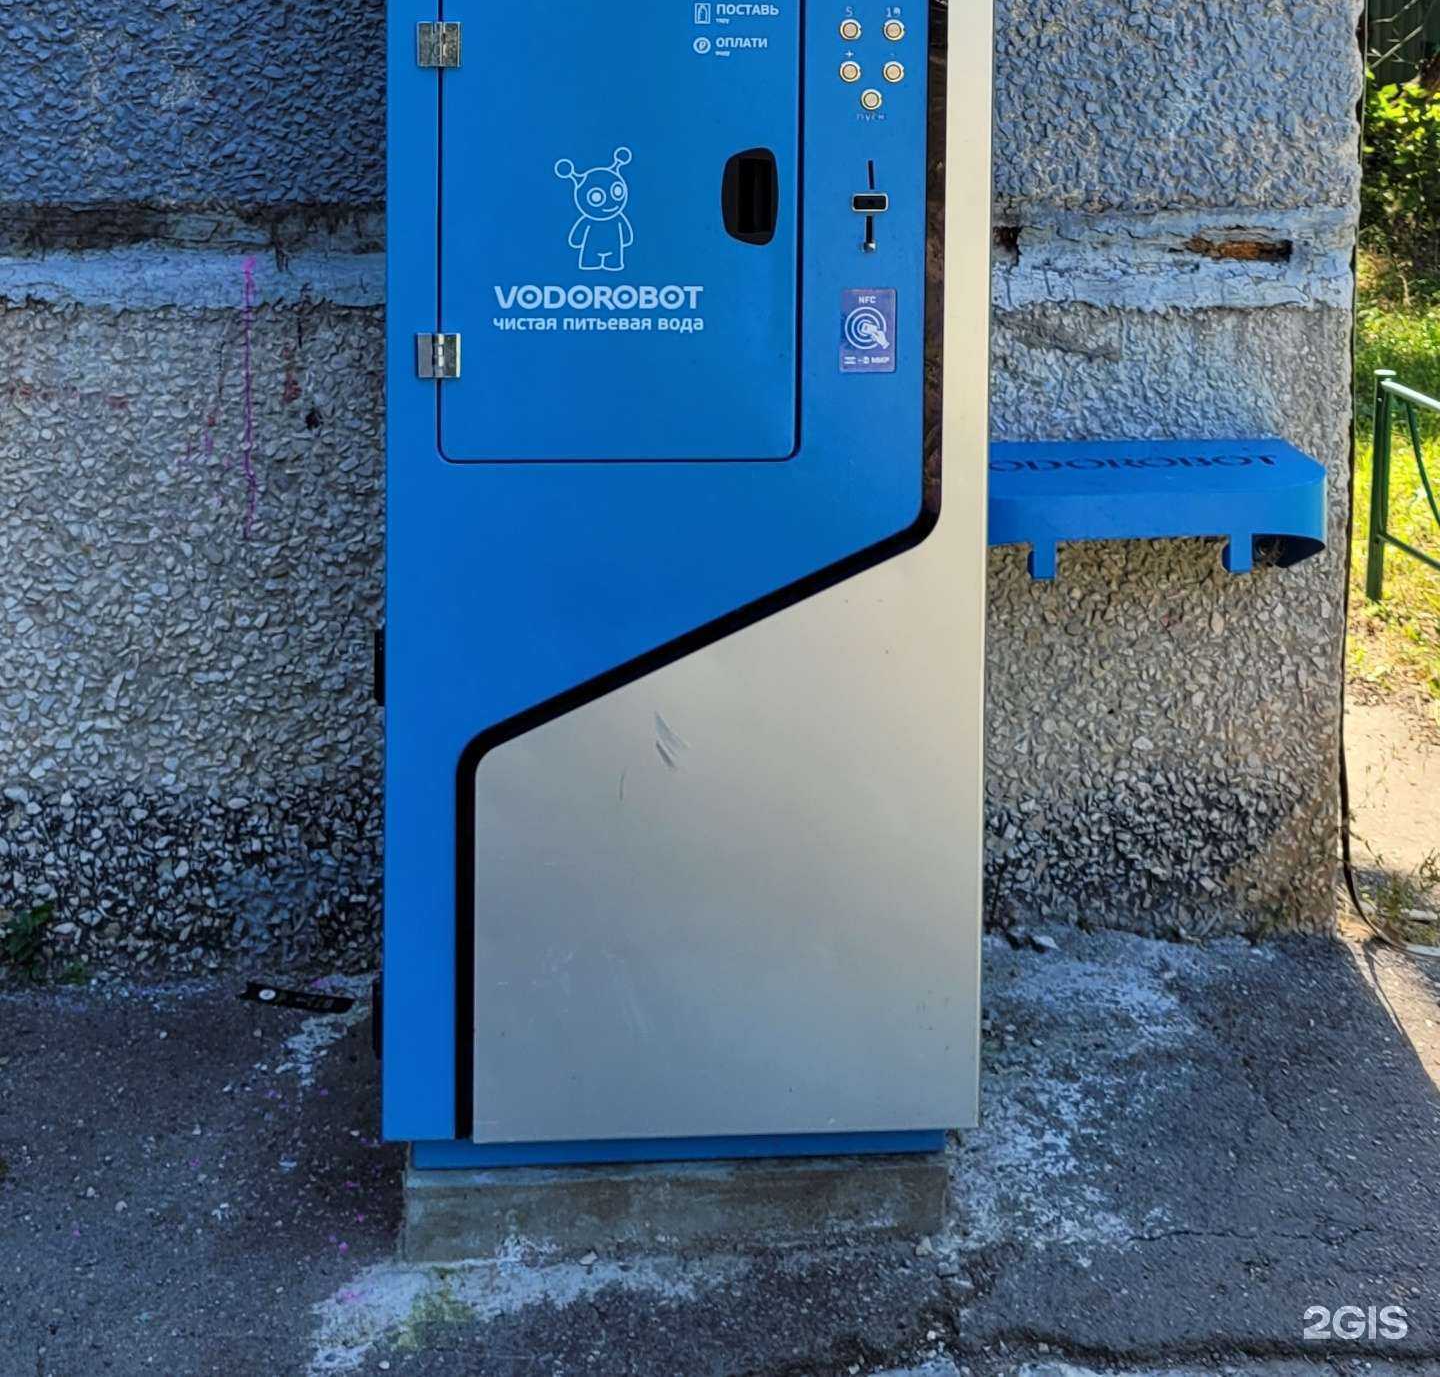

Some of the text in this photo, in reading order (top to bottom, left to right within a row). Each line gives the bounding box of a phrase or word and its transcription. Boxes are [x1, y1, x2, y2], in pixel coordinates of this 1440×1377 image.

[716, 3, 779, 16] ПОСТАВЬ
[715, 37, 768, 49] ОПЛАТИ
[494, 284, 704, 310] VODOROBOT
[858, 295, 877, 304] NFC
[493, 317, 705, 333] чистая питьевая вода
